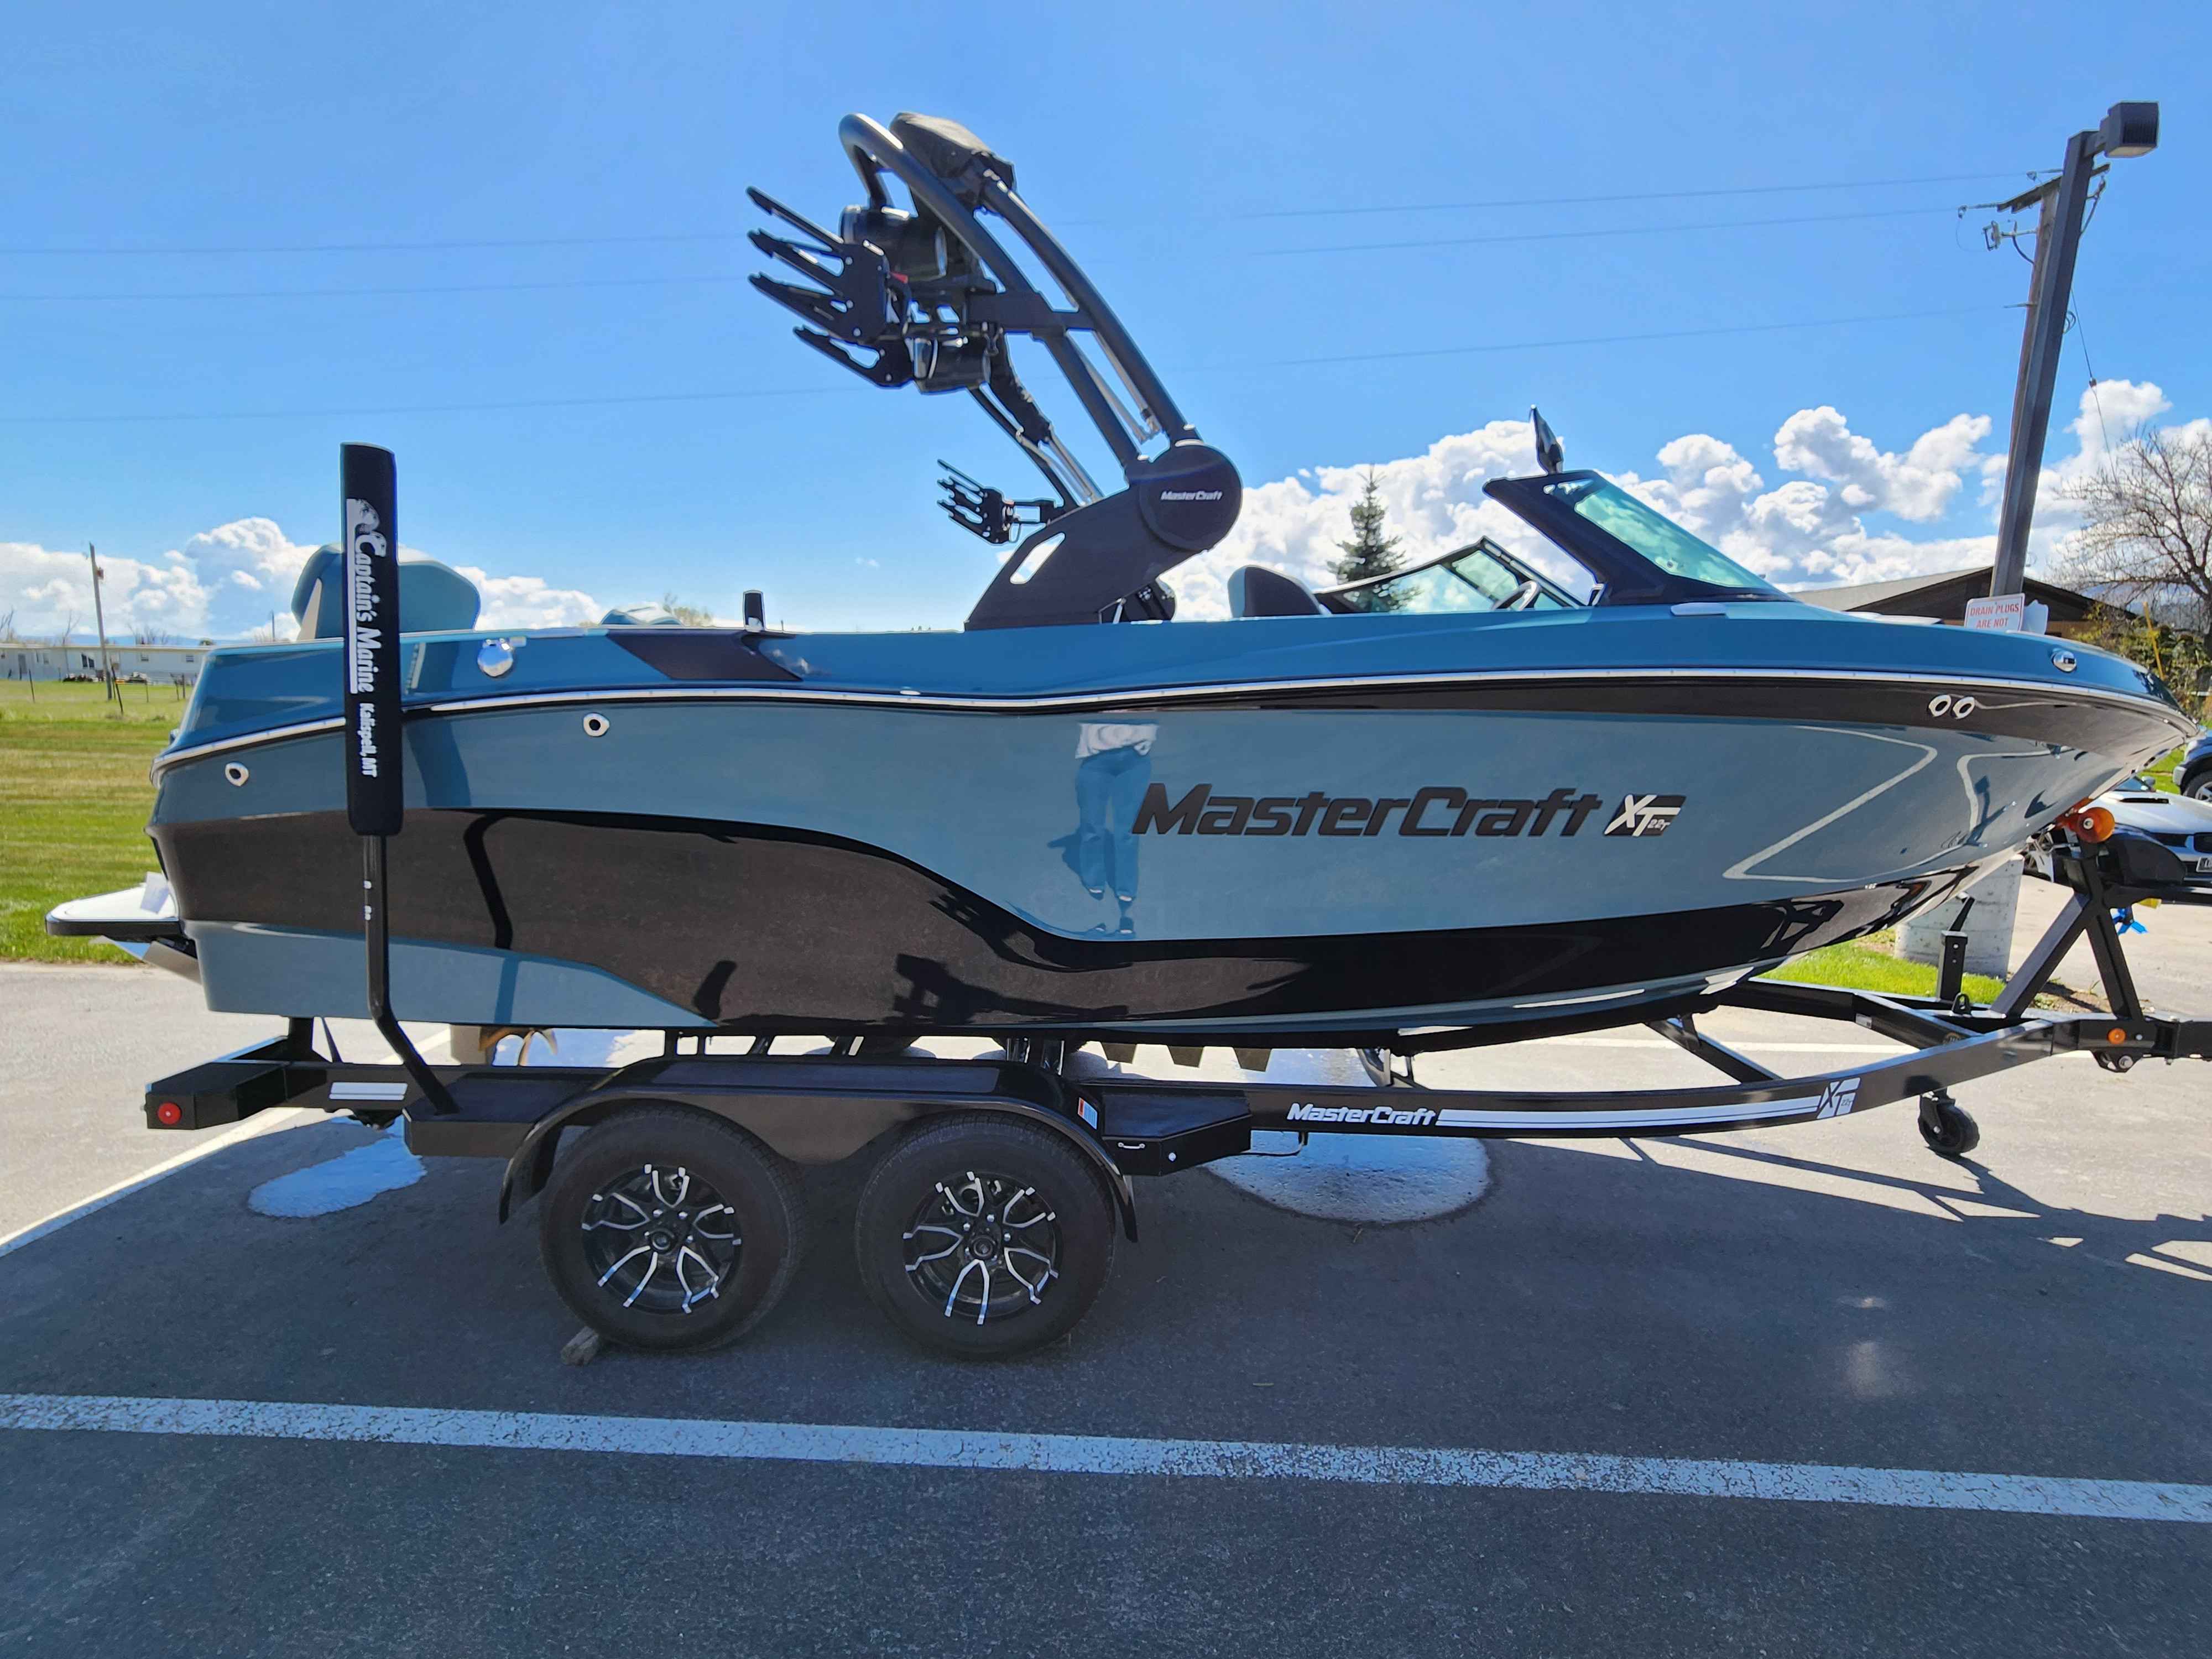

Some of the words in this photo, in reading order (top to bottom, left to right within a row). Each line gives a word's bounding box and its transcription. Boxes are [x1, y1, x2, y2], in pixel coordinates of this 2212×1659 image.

[1161, 491, 1223, 500] MasterCraft
[355, 531, 387, 622] Captain's
[1970, 607, 1992, 616] DRAIN
[1995, 603, 2019, 614] PLUGS
[1976, 619, 1991, 628] ARE
[1994, 618, 2008, 627] NOT
[356, 626, 382, 692] Marine
[361, 757, 377, 777] MT
[1131, 782, 1603, 836] MasterCraft
[1604, 794, 1681, 837] XT
[1287, 1103, 1436, 1125] MasterCraft
